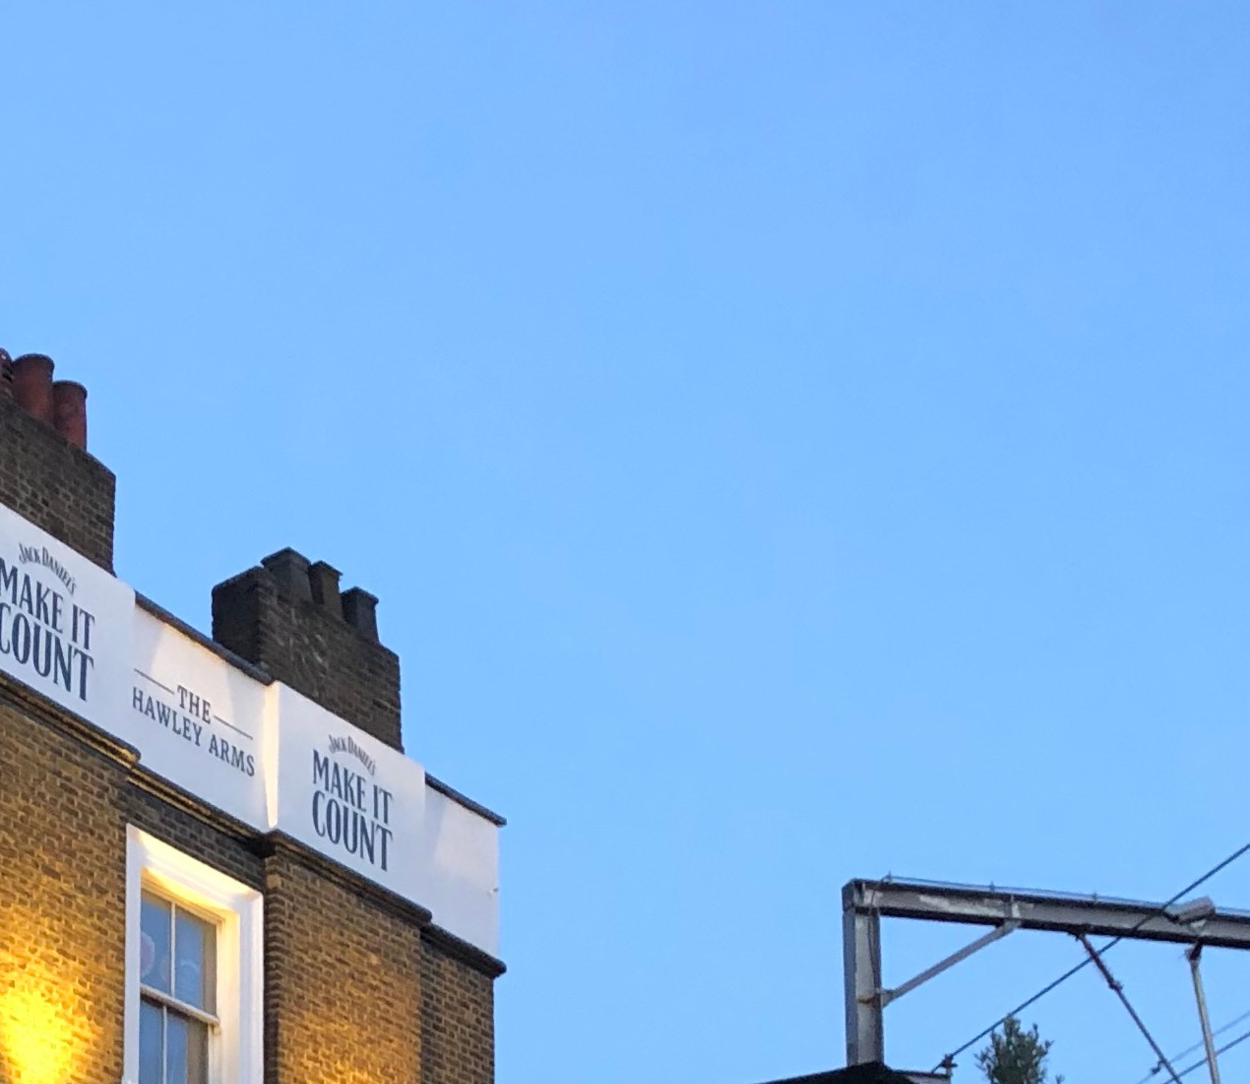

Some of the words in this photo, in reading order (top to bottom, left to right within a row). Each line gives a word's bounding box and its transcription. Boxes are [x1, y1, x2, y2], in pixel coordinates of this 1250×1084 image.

[18, 542, 41, 565] JACK
[71, 602, 96, 651] IT
[132, 686, 203, 747] HAWLEY
[208, 733, 255, 777] ARMS
[176, 683, 212, 725] THE
[312, 748, 367, 813] MAKE
[373, 783, 394, 825] IT
[311, 789, 394, 872] COUNT
